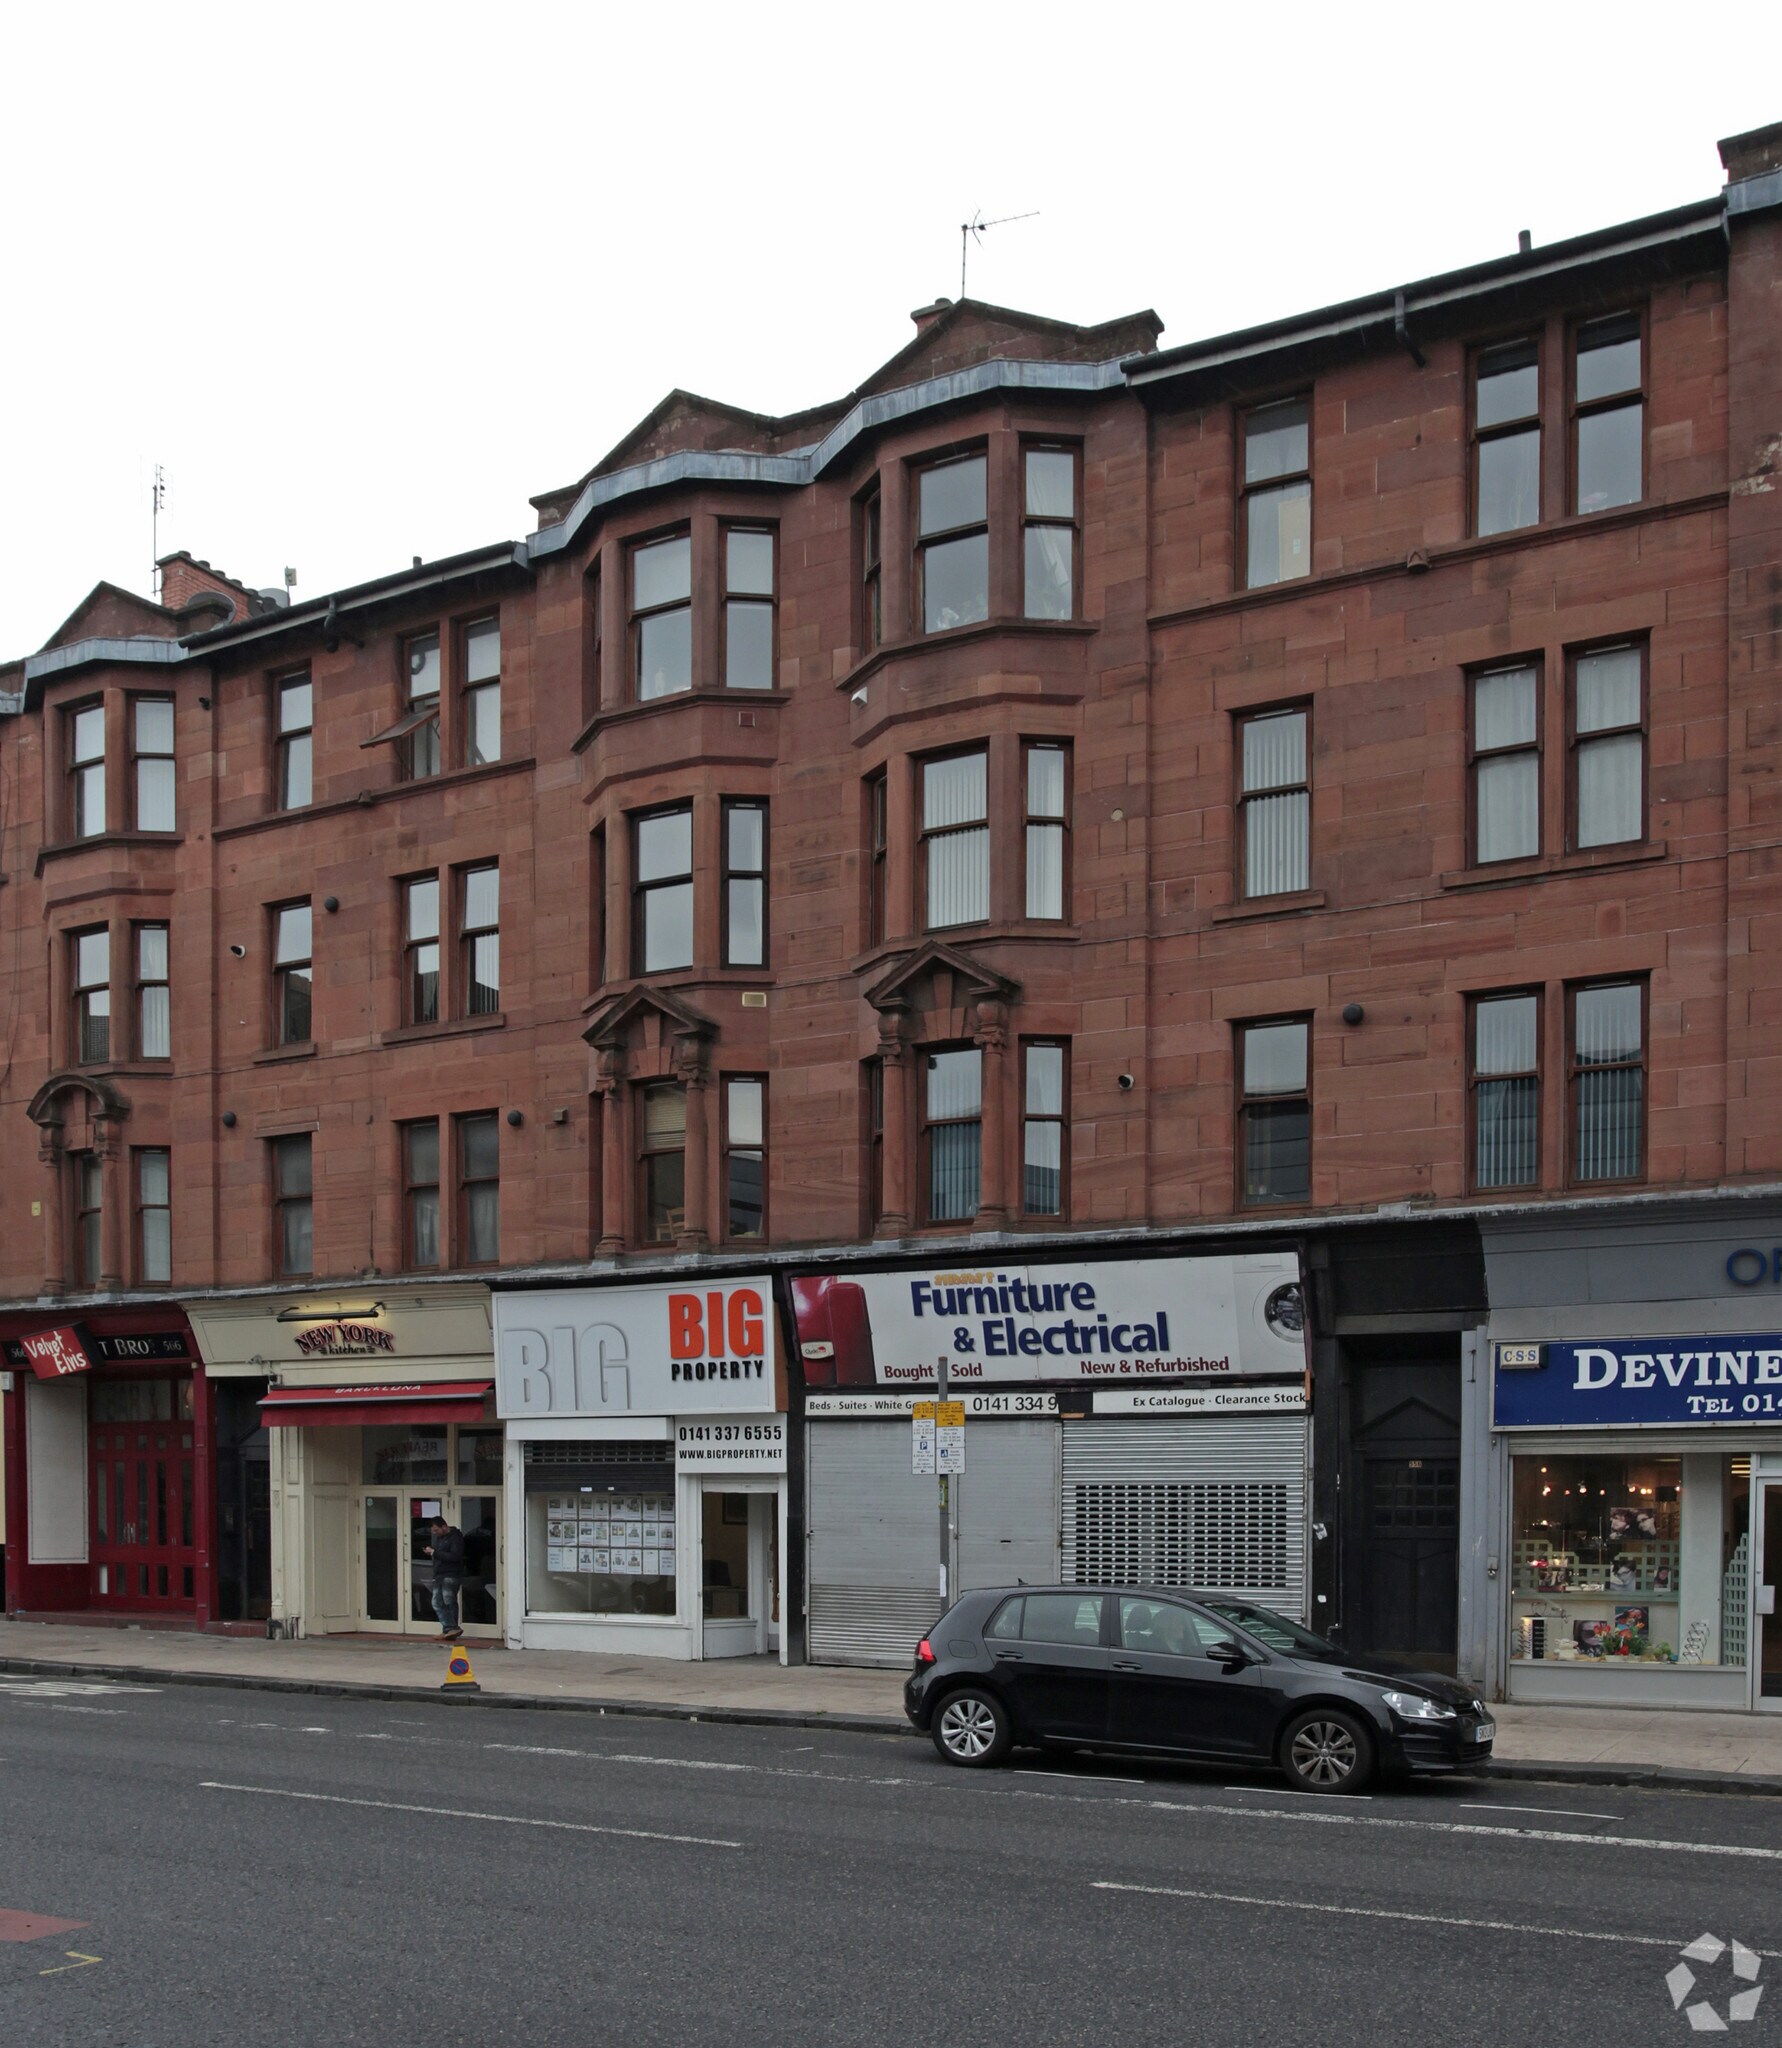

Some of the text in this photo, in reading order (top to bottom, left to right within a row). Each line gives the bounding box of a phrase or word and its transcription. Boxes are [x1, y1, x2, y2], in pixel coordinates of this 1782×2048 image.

[910, 1274, 1096, 1317] Furniture
[668, 1289, 764, 1359] BIG
[953, 1311, 1170, 1356] & Electrical
[24, 1330, 65, 1359] Velvet
[163, 1339, 182, 1352] 566
[295, 1322, 395, 1355] NEW YORK
[328, 1344, 368, 1355] kitchen
[52, 1347, 87, 1375] Elvis
[503, 1322, 632, 1412] BIG
[1080, 1356, 1230, 1374] New & Refurbished
[1572, 1348, 1782, 1390] DEVINE
[671, 1360, 764, 1382] PROPERTY
[884, 1364, 935, 1381] Bought
[951, 1362, 983, 1377] Sold
[809, 1401, 832, 1411] Beds
[838, 1400, 867, 1410] Suites
[874, 1399, 903, 1410] White
[973, 1396, 1009, 1412] 0141
[1015, 1396, 1044, 1411] 334
[1133, 1392, 1306, 1408] Ex Catalogue Clearance Stock
[1686, 1395, 1734, 1414] TEL
[679, 1425, 782, 1441] 0141 337 6555
[679, 1448, 782, 1460] WWW.BIGPROPERTY.NET
